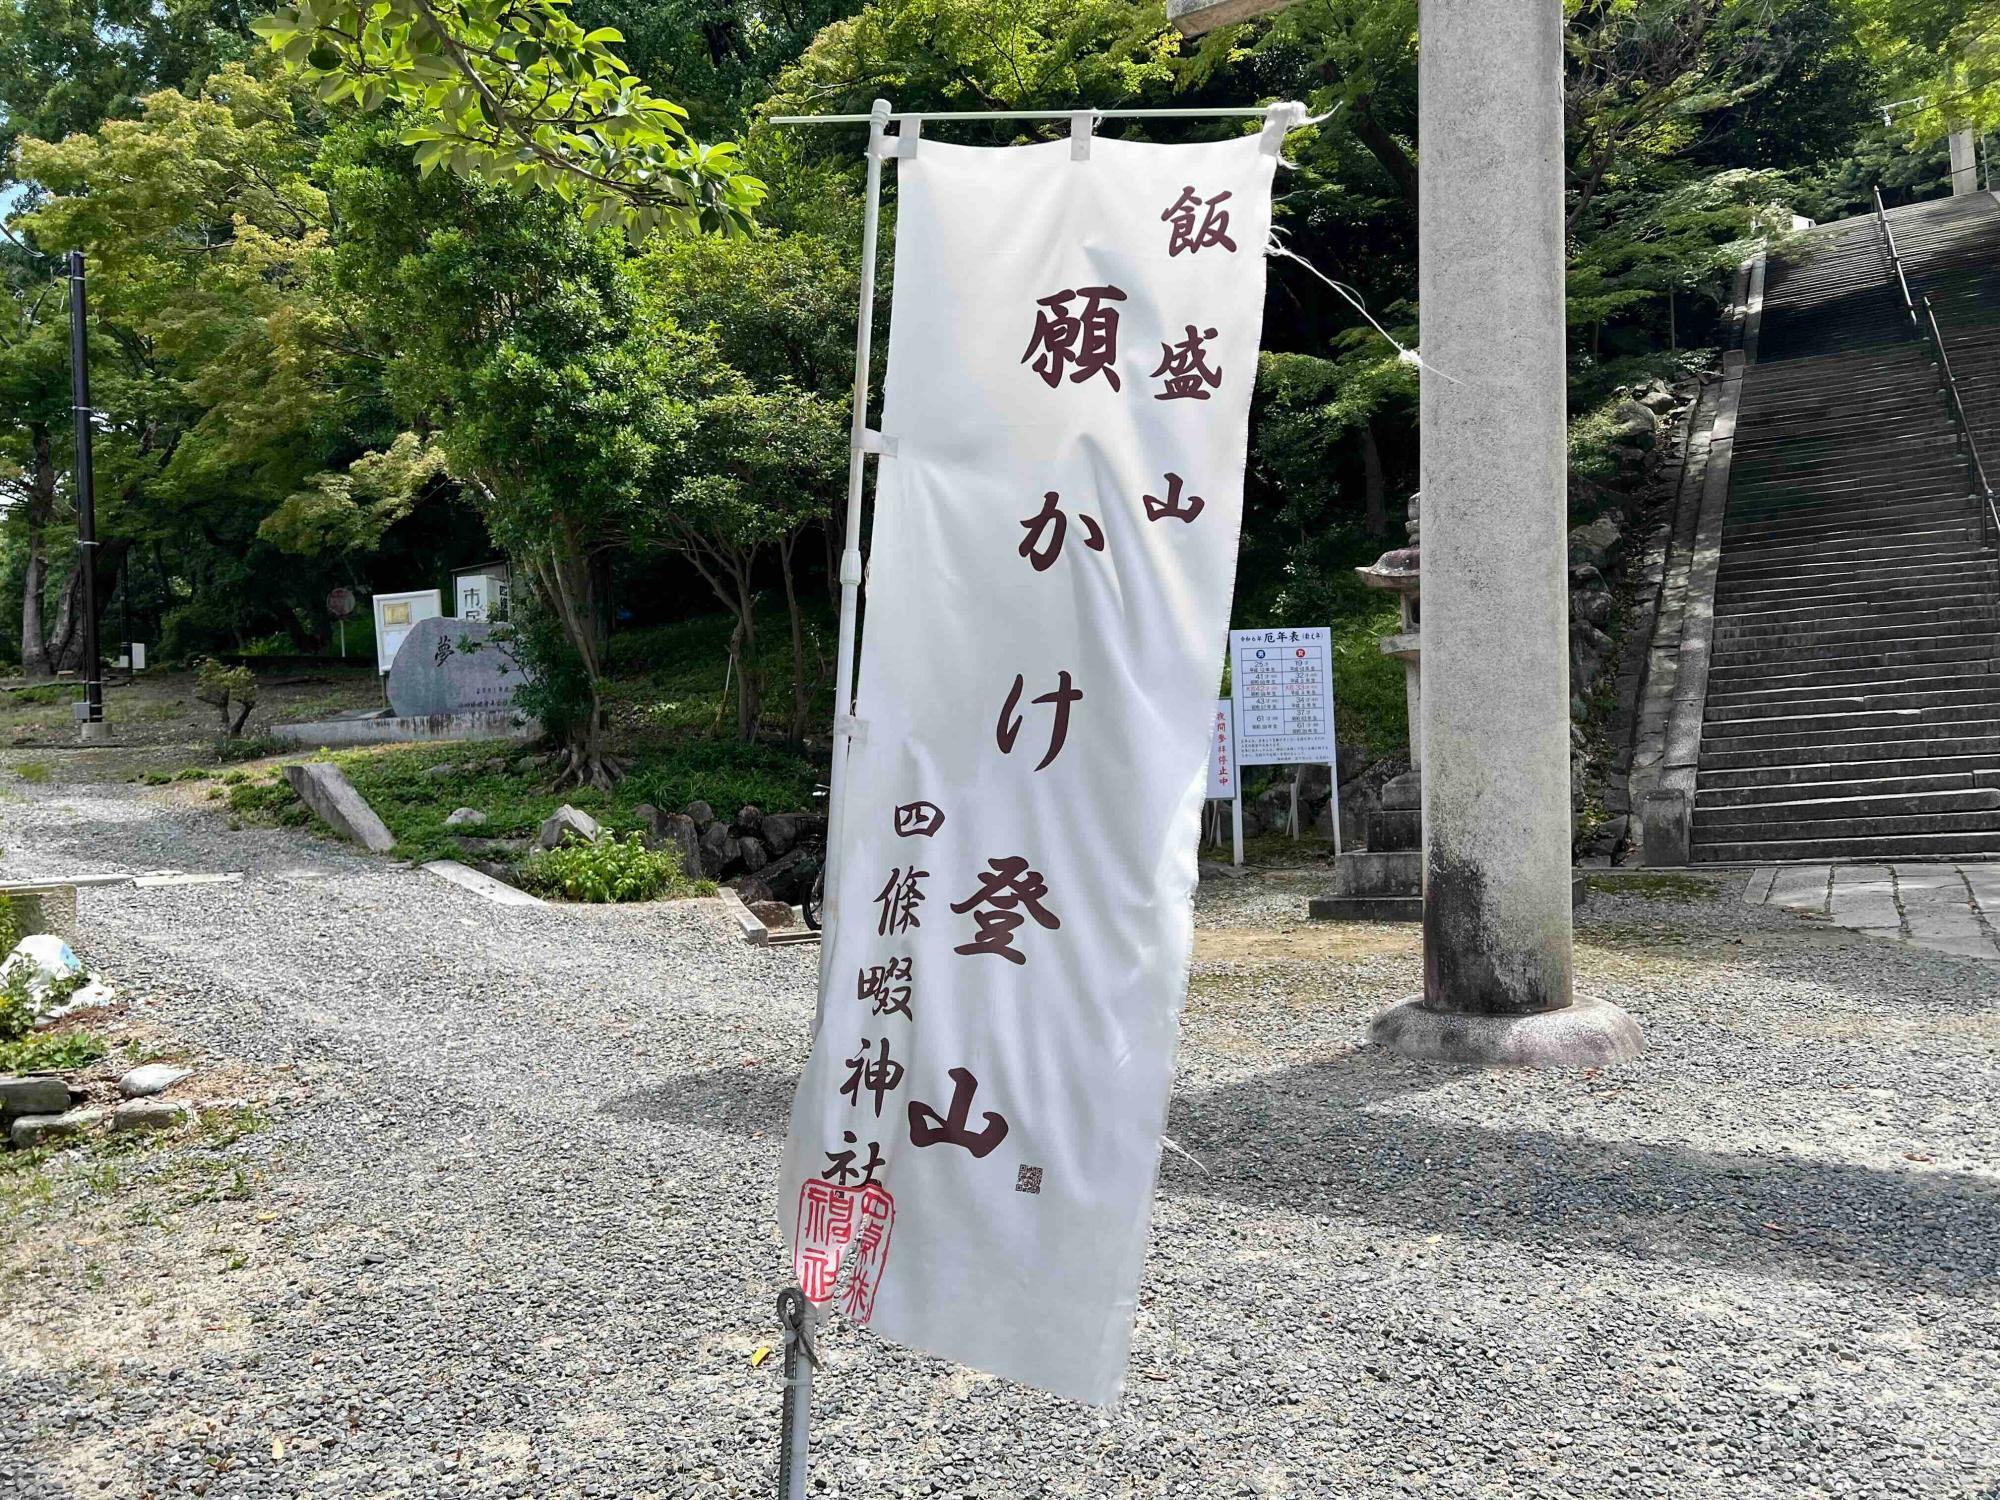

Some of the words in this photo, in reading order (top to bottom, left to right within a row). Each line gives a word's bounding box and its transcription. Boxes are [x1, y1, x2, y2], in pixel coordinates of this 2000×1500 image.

[1142, 185, 1237, 523] 飯盛山
[434, 634, 455, 667] 夢
[908, 284, 1128, 1159] 願かけ登山
[1264, 631, 1301, 643] 厄年表
[820, 800, 945, 1198] 四條畷神社
